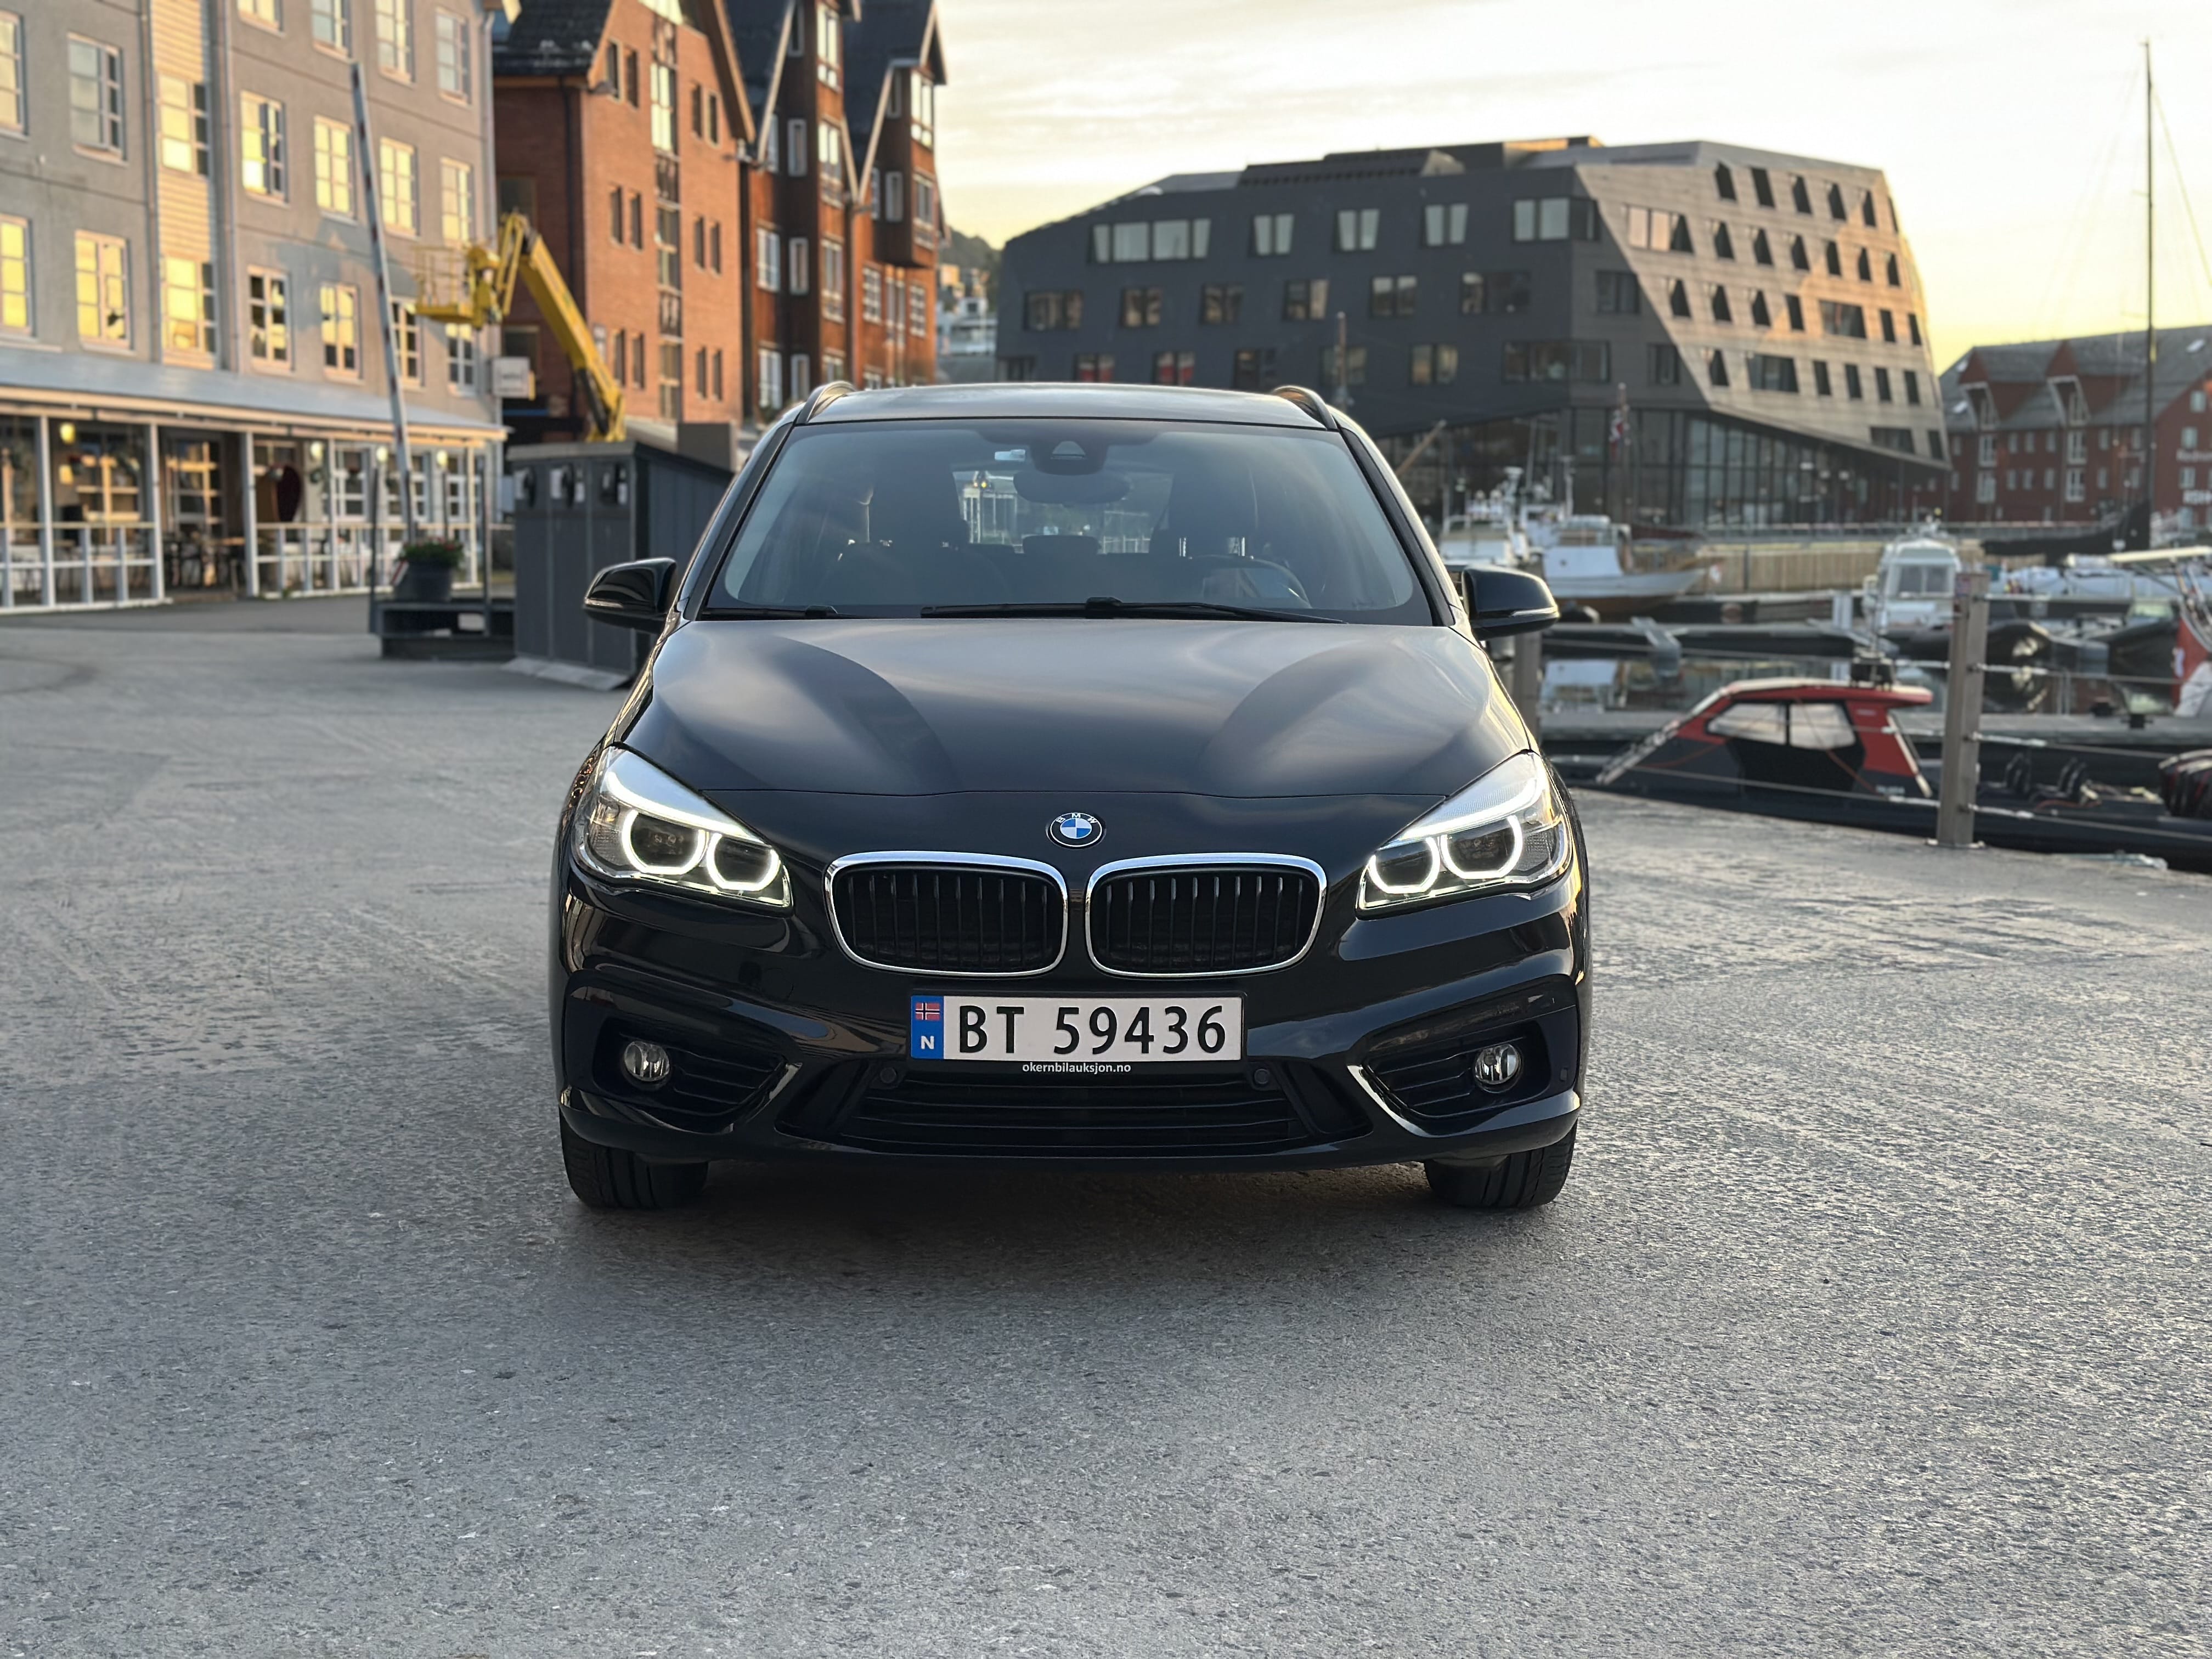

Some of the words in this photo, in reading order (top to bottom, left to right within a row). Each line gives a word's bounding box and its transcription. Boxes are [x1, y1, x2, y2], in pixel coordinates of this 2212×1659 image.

[1056, 812, 1097, 823] BMW
[959, 1005, 1024, 1054] BT
[1053, 1006, 1226, 1054] 59436
[921, 1035, 934, 1049] N
[1022, 1062, 1131, 1075] okernbilauksjon.no
